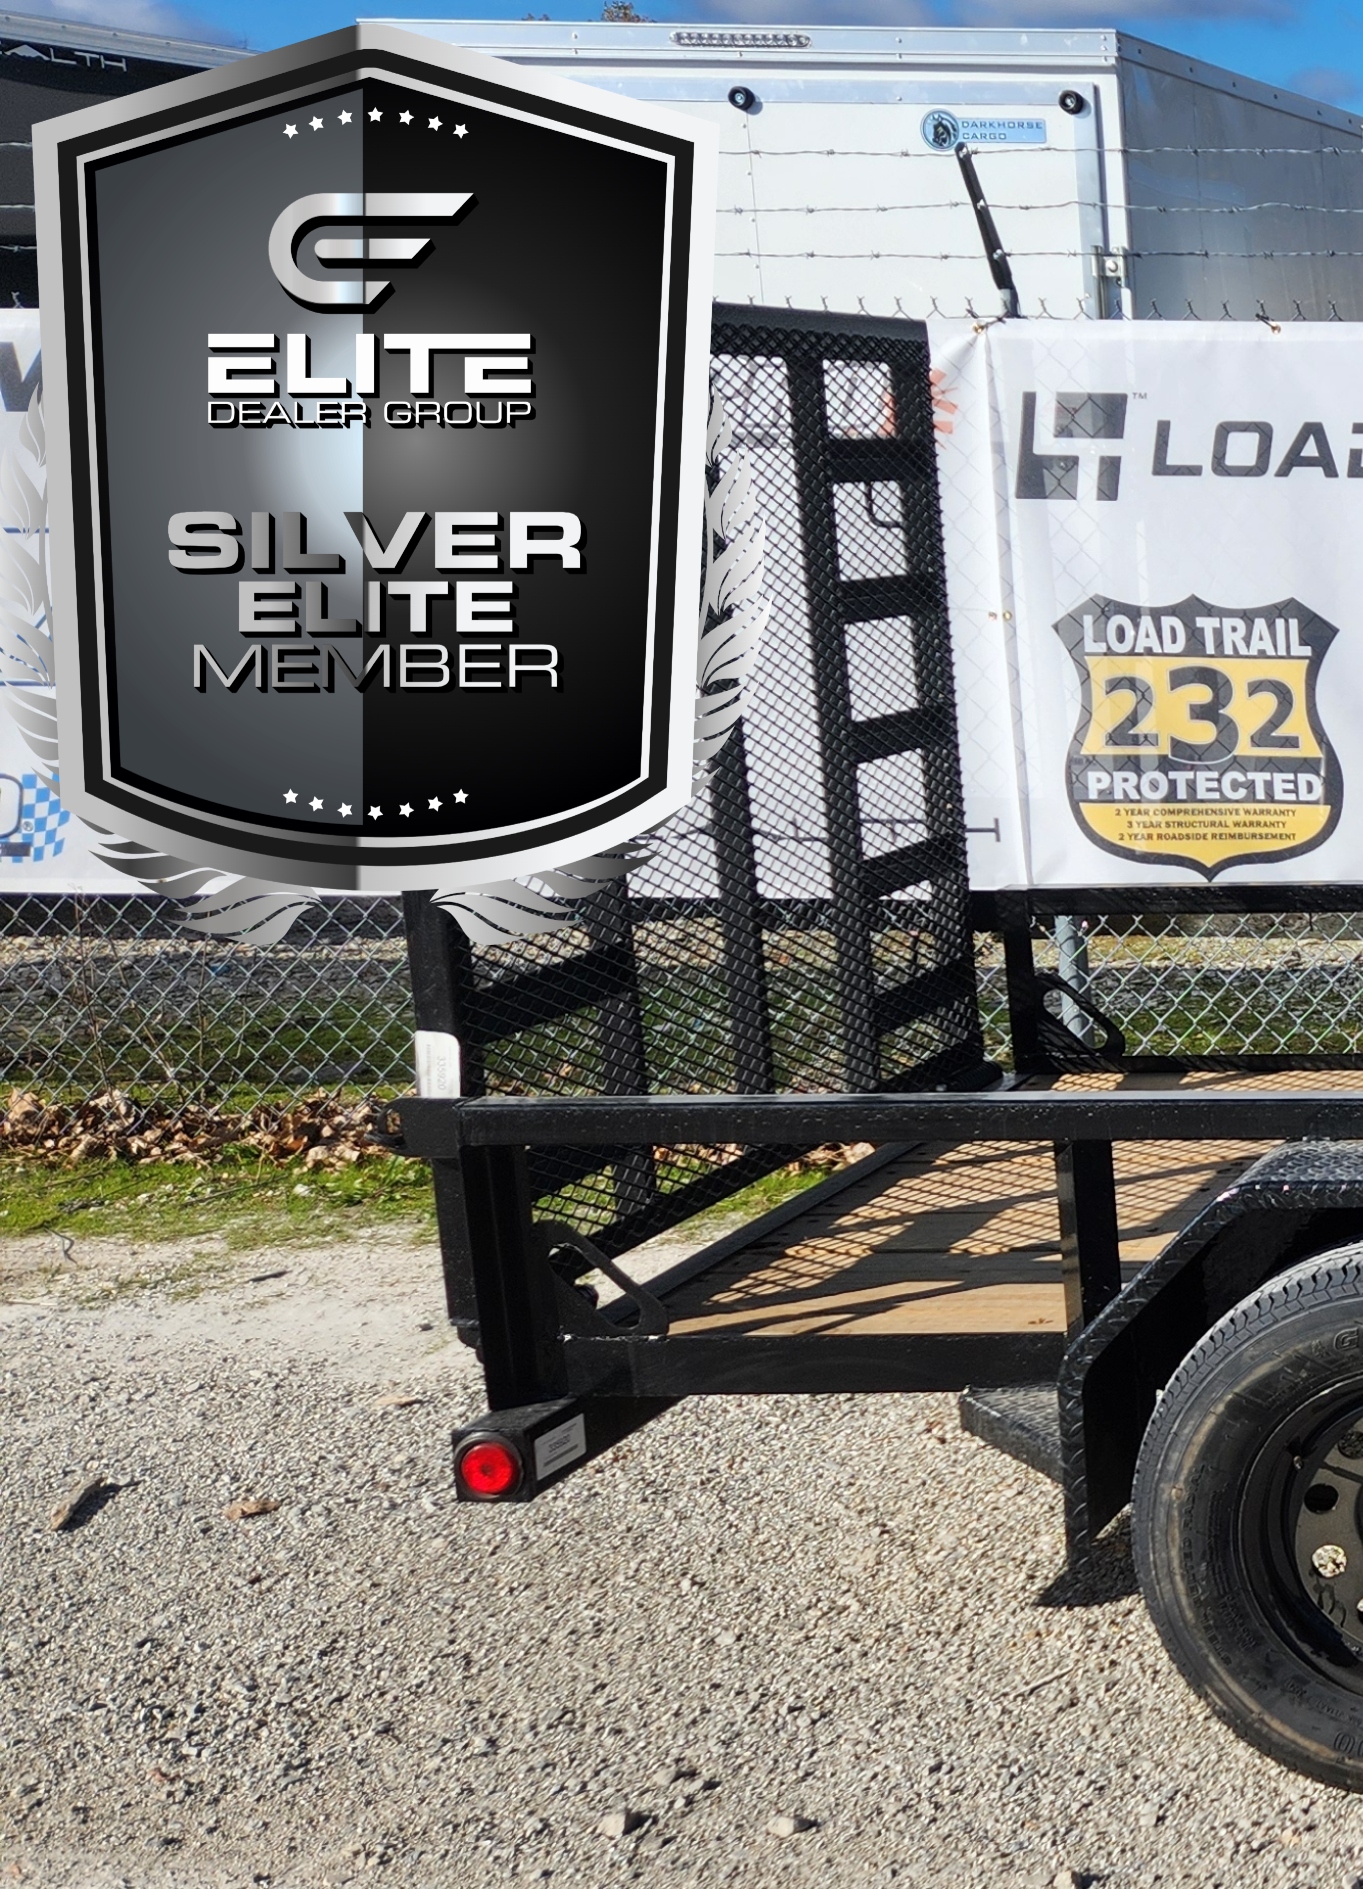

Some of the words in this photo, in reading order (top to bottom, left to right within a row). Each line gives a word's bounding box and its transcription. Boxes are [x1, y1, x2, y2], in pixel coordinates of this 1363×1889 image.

[0, 42, 127, 72] ALTH
[961, 120, 1043, 130] DARKHORSE
[962, 132, 1007, 140] CARGO
[1083, 614, 1187, 654] LOAD
[1195, 617, 1312, 657] TRAIL
[1103, 665, 1301, 765] 232
[1087, 771, 1323, 801] PROTECTED
[1115, 808, 1121, 816] 2
[1124, 808, 1150, 816] YEAR
[1153, 808, 1240, 817] COMPREHENSIVE
[1243, 808, 1297, 817] WARRANTY
[1136, 821, 1162, 829] YEAR
[1165, 821, 1229, 829] STRUCTURAL
[1233, 821, 1287, 829] WARRANTY
[1118, 833, 1125, 841] 2
[1127, 833, 1153, 841] YEAR
[1157, 833, 1208, 841] ROADSIDE
[1211, 832, 1297, 841] REIMBURSEMENT
